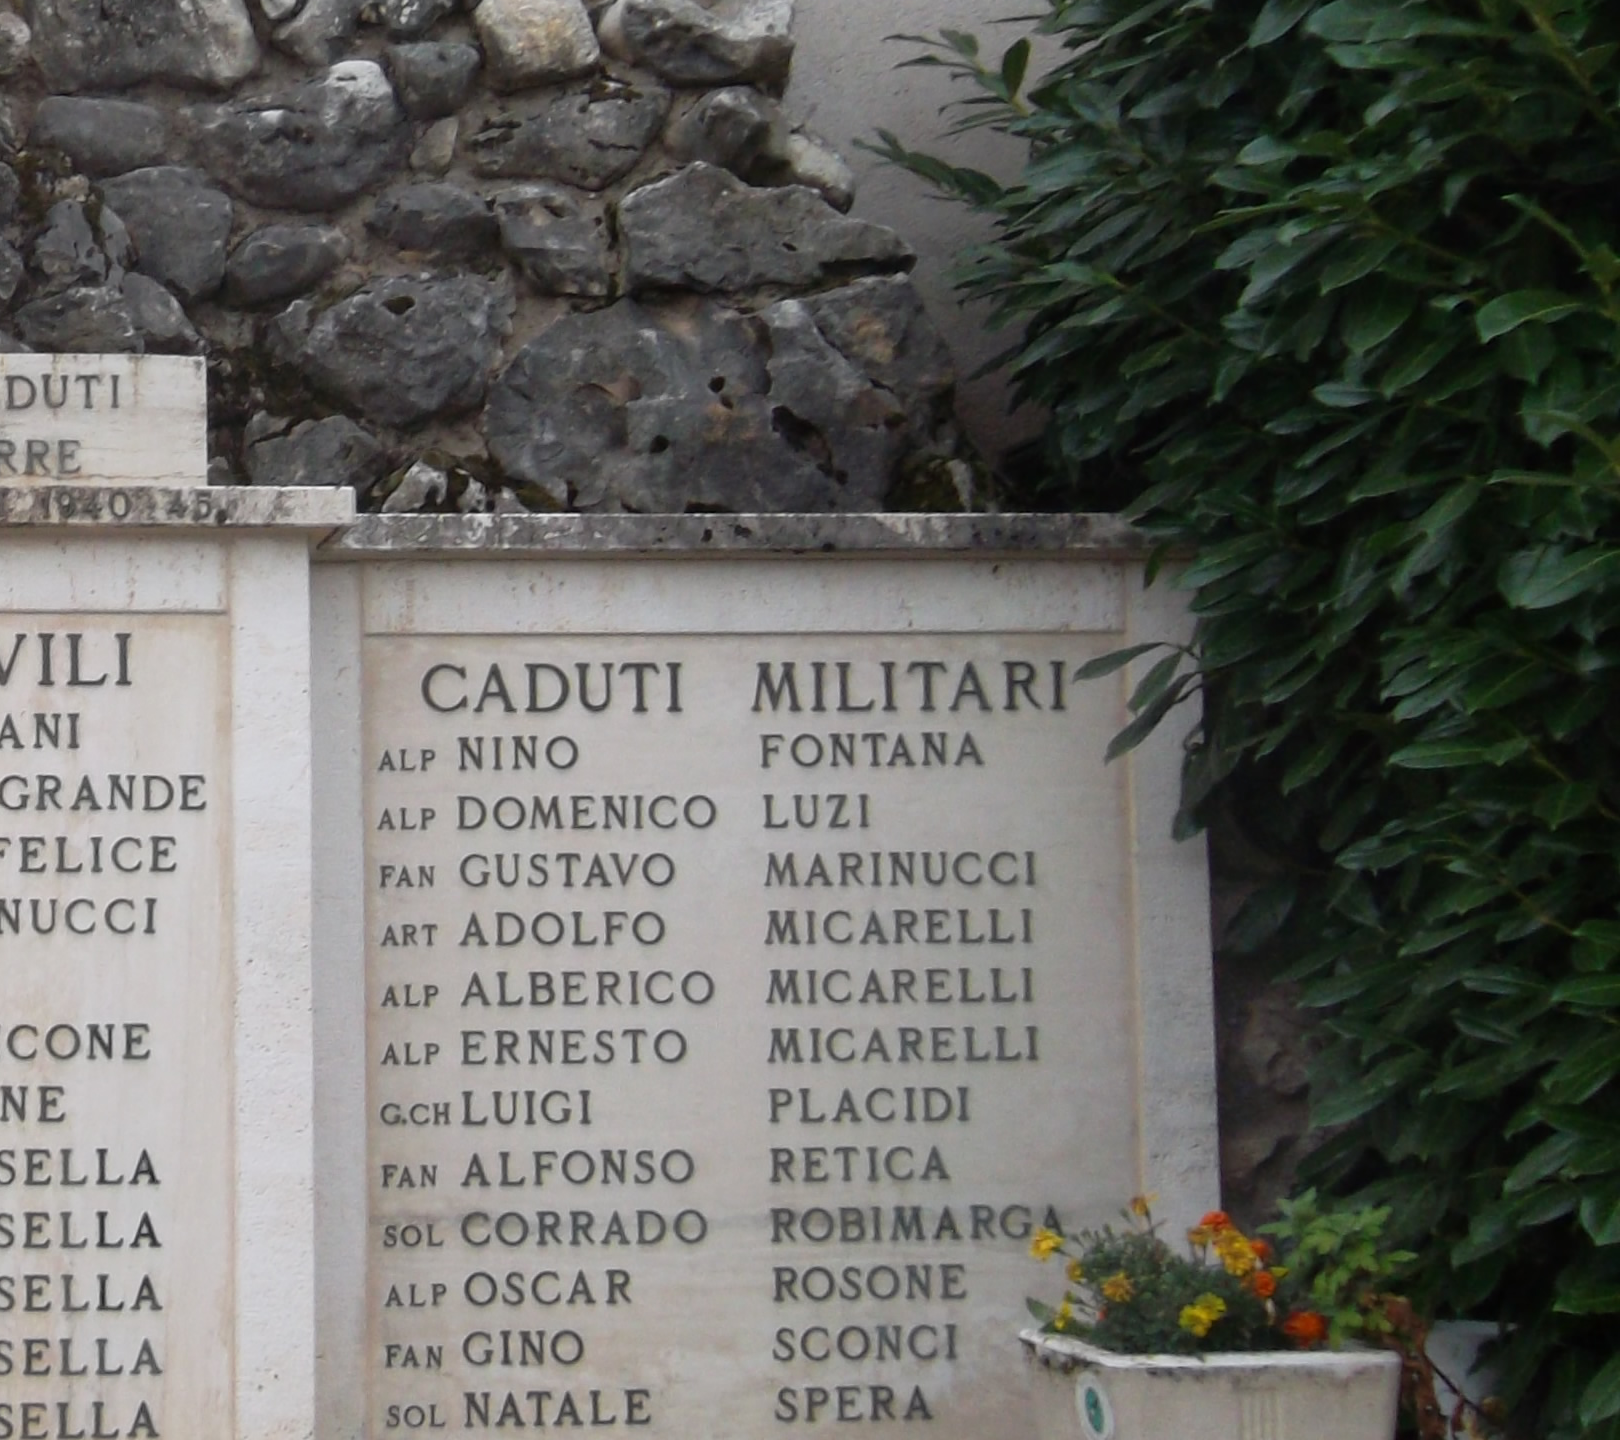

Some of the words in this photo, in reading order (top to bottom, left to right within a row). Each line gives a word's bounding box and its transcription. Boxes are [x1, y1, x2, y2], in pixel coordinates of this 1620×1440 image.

[422, 662, 682, 713] CADUTI
[752, 660, 1068, 713] MILITARI
[378, 749, 435, 771] ALP
[458, 736, 578, 771] NINO
[761, 732, 984, 768] FONTANA
[377, 808, 435, 830] ALP
[458, 795, 717, 830] DOMENICO
[763, 794, 869, 829] LUZI
[380, 865, 434, 889] FAN
[460, 853, 675, 888] GUSTAVO
[765, 851, 1037, 887] MARINUCCI
[381, 924, 437, 947] ART
[460, 912, 665, 946] ADOLFO
[765, 908, 1033, 945] MICARELLI
[381, 984, 438, 1007] ALP
[461, 971, 715, 1007] ALBERICO
[767, 967, 1034, 1004] MICARELLI
[381, 1043, 439, 1066] ALP
[461, 1029, 687, 1065] ERNESTO
[768, 1025, 1039, 1063] MICARELLI
[462, 1090, 591, 1126] LUIGI
[769, 1086, 970, 1123] PLACIDI
[382, 1164, 437, 1188] FAN
[461, 1149, 694, 1187] ALFONSO
[770, 1146, 950, 1183] RETICA
[383, 1223, 443, 1248] SOL
[461, 1209, 708, 1247] CORRADO
[770, 1205, 1064, 1243] ROBIMARGA
[385, 1284, 446, 1308] ALP
[464, 1270, 631, 1307] OSCAR
[774, 1264, 967, 1303] ROSONE
[386, 1344, 442, 1368] FAN
[463, 1330, 584, 1366] GINO
[773, 1324, 958, 1362] SCONCI
[386, 1404, 446, 1429] SOL
[464, 1389, 651, 1428] NATALE
[775, 1385, 935, 1423] SPERA
